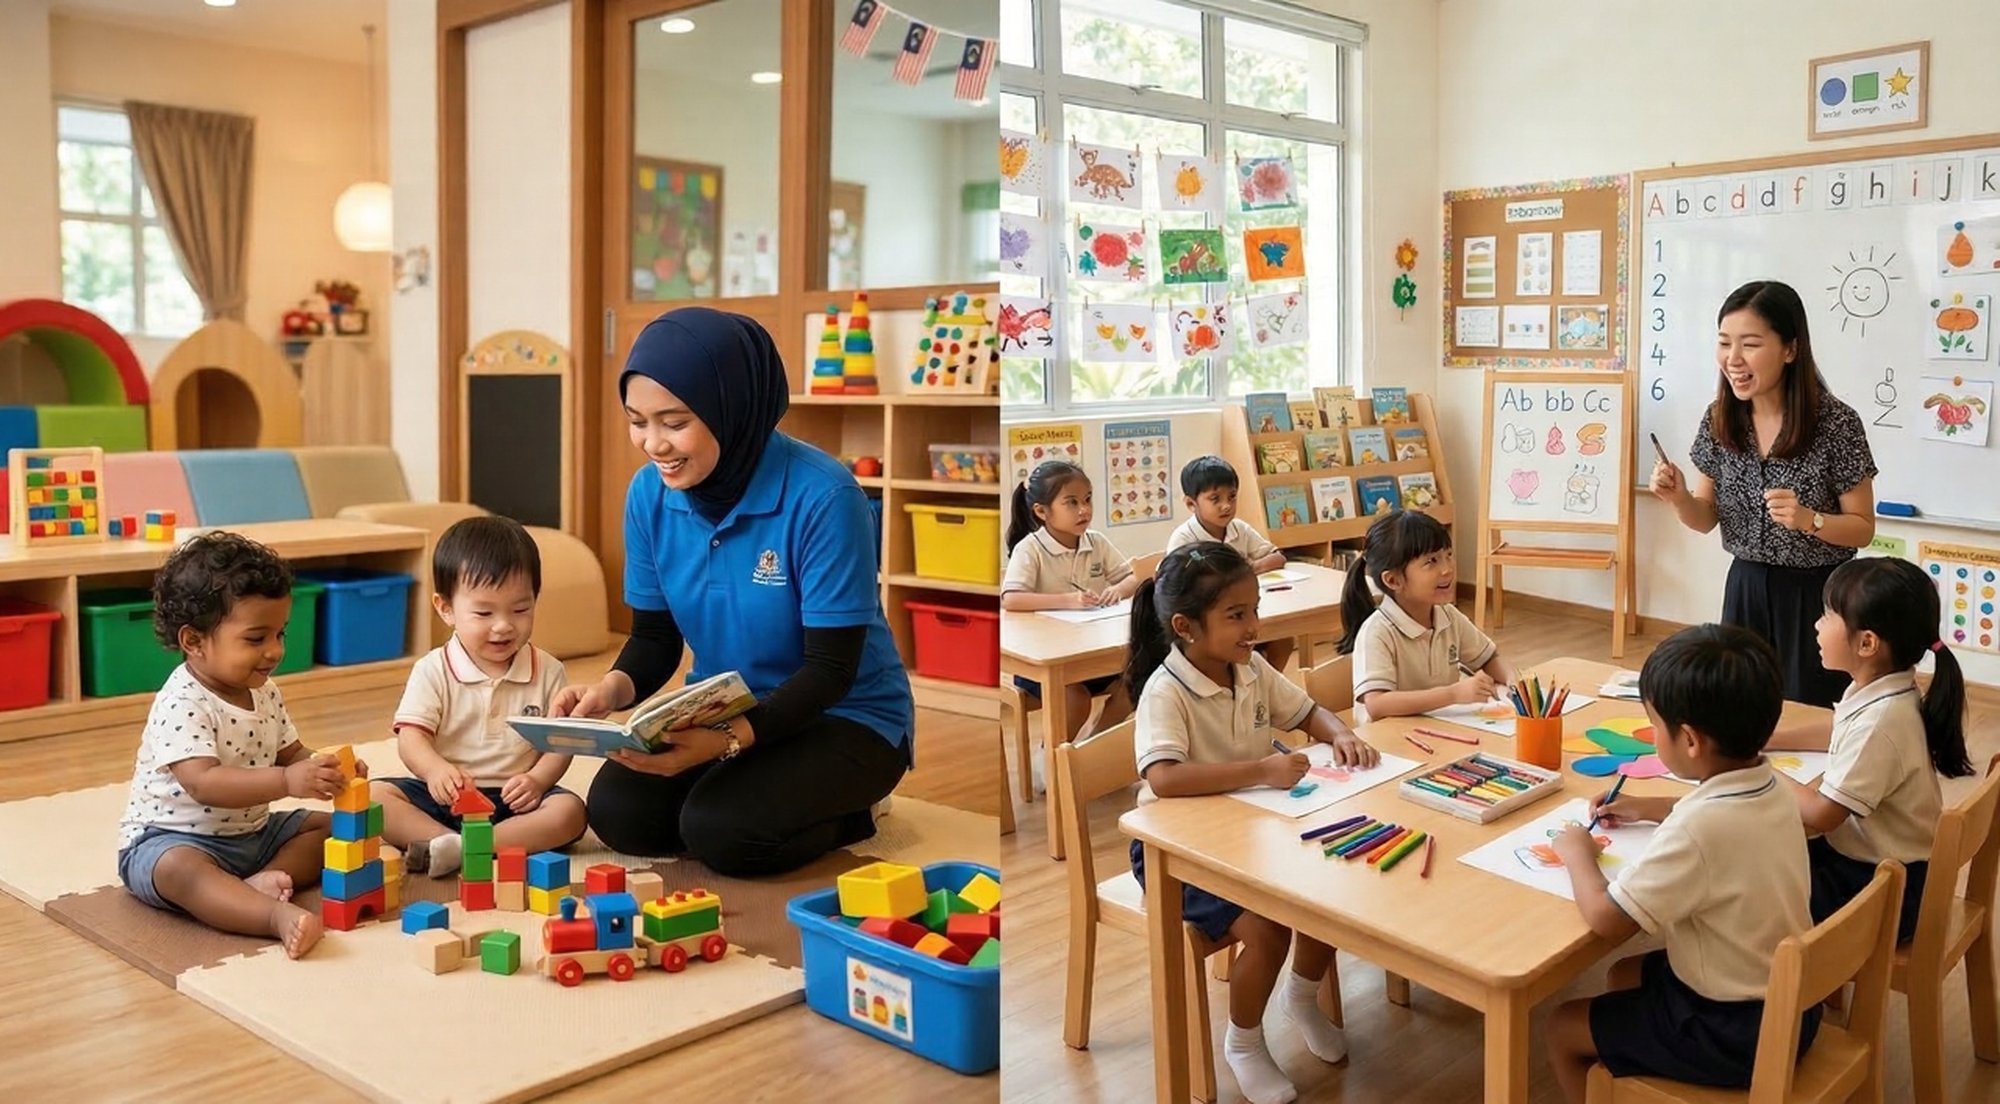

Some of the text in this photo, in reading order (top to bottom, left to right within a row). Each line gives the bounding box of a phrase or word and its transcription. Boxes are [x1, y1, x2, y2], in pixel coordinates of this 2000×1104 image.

[1647, 192, 1665, 217] A
[1676, 189, 1690, 214] b
[1703, 195, 1717, 212] c
[1731, 184, 1746, 209] d
[1760, 181, 1776, 207] d
[1793, 176, 1807, 205] f
[1869, 171, 1885, 200] h
[1912, 170, 1918, 197] i
[1939, 166, 1952, 202] j
[1981, 161, 1997, 192] k
[1654, 239, 1663, 263] 1
[1652, 273, 1667, 298] 2
[1652, 307, 1666, 332] 3
[1650, 342, 1667, 367] 4
[1500, 387, 1611, 413] Ab bb Cc
[1650, 377, 1666, 402] 6
